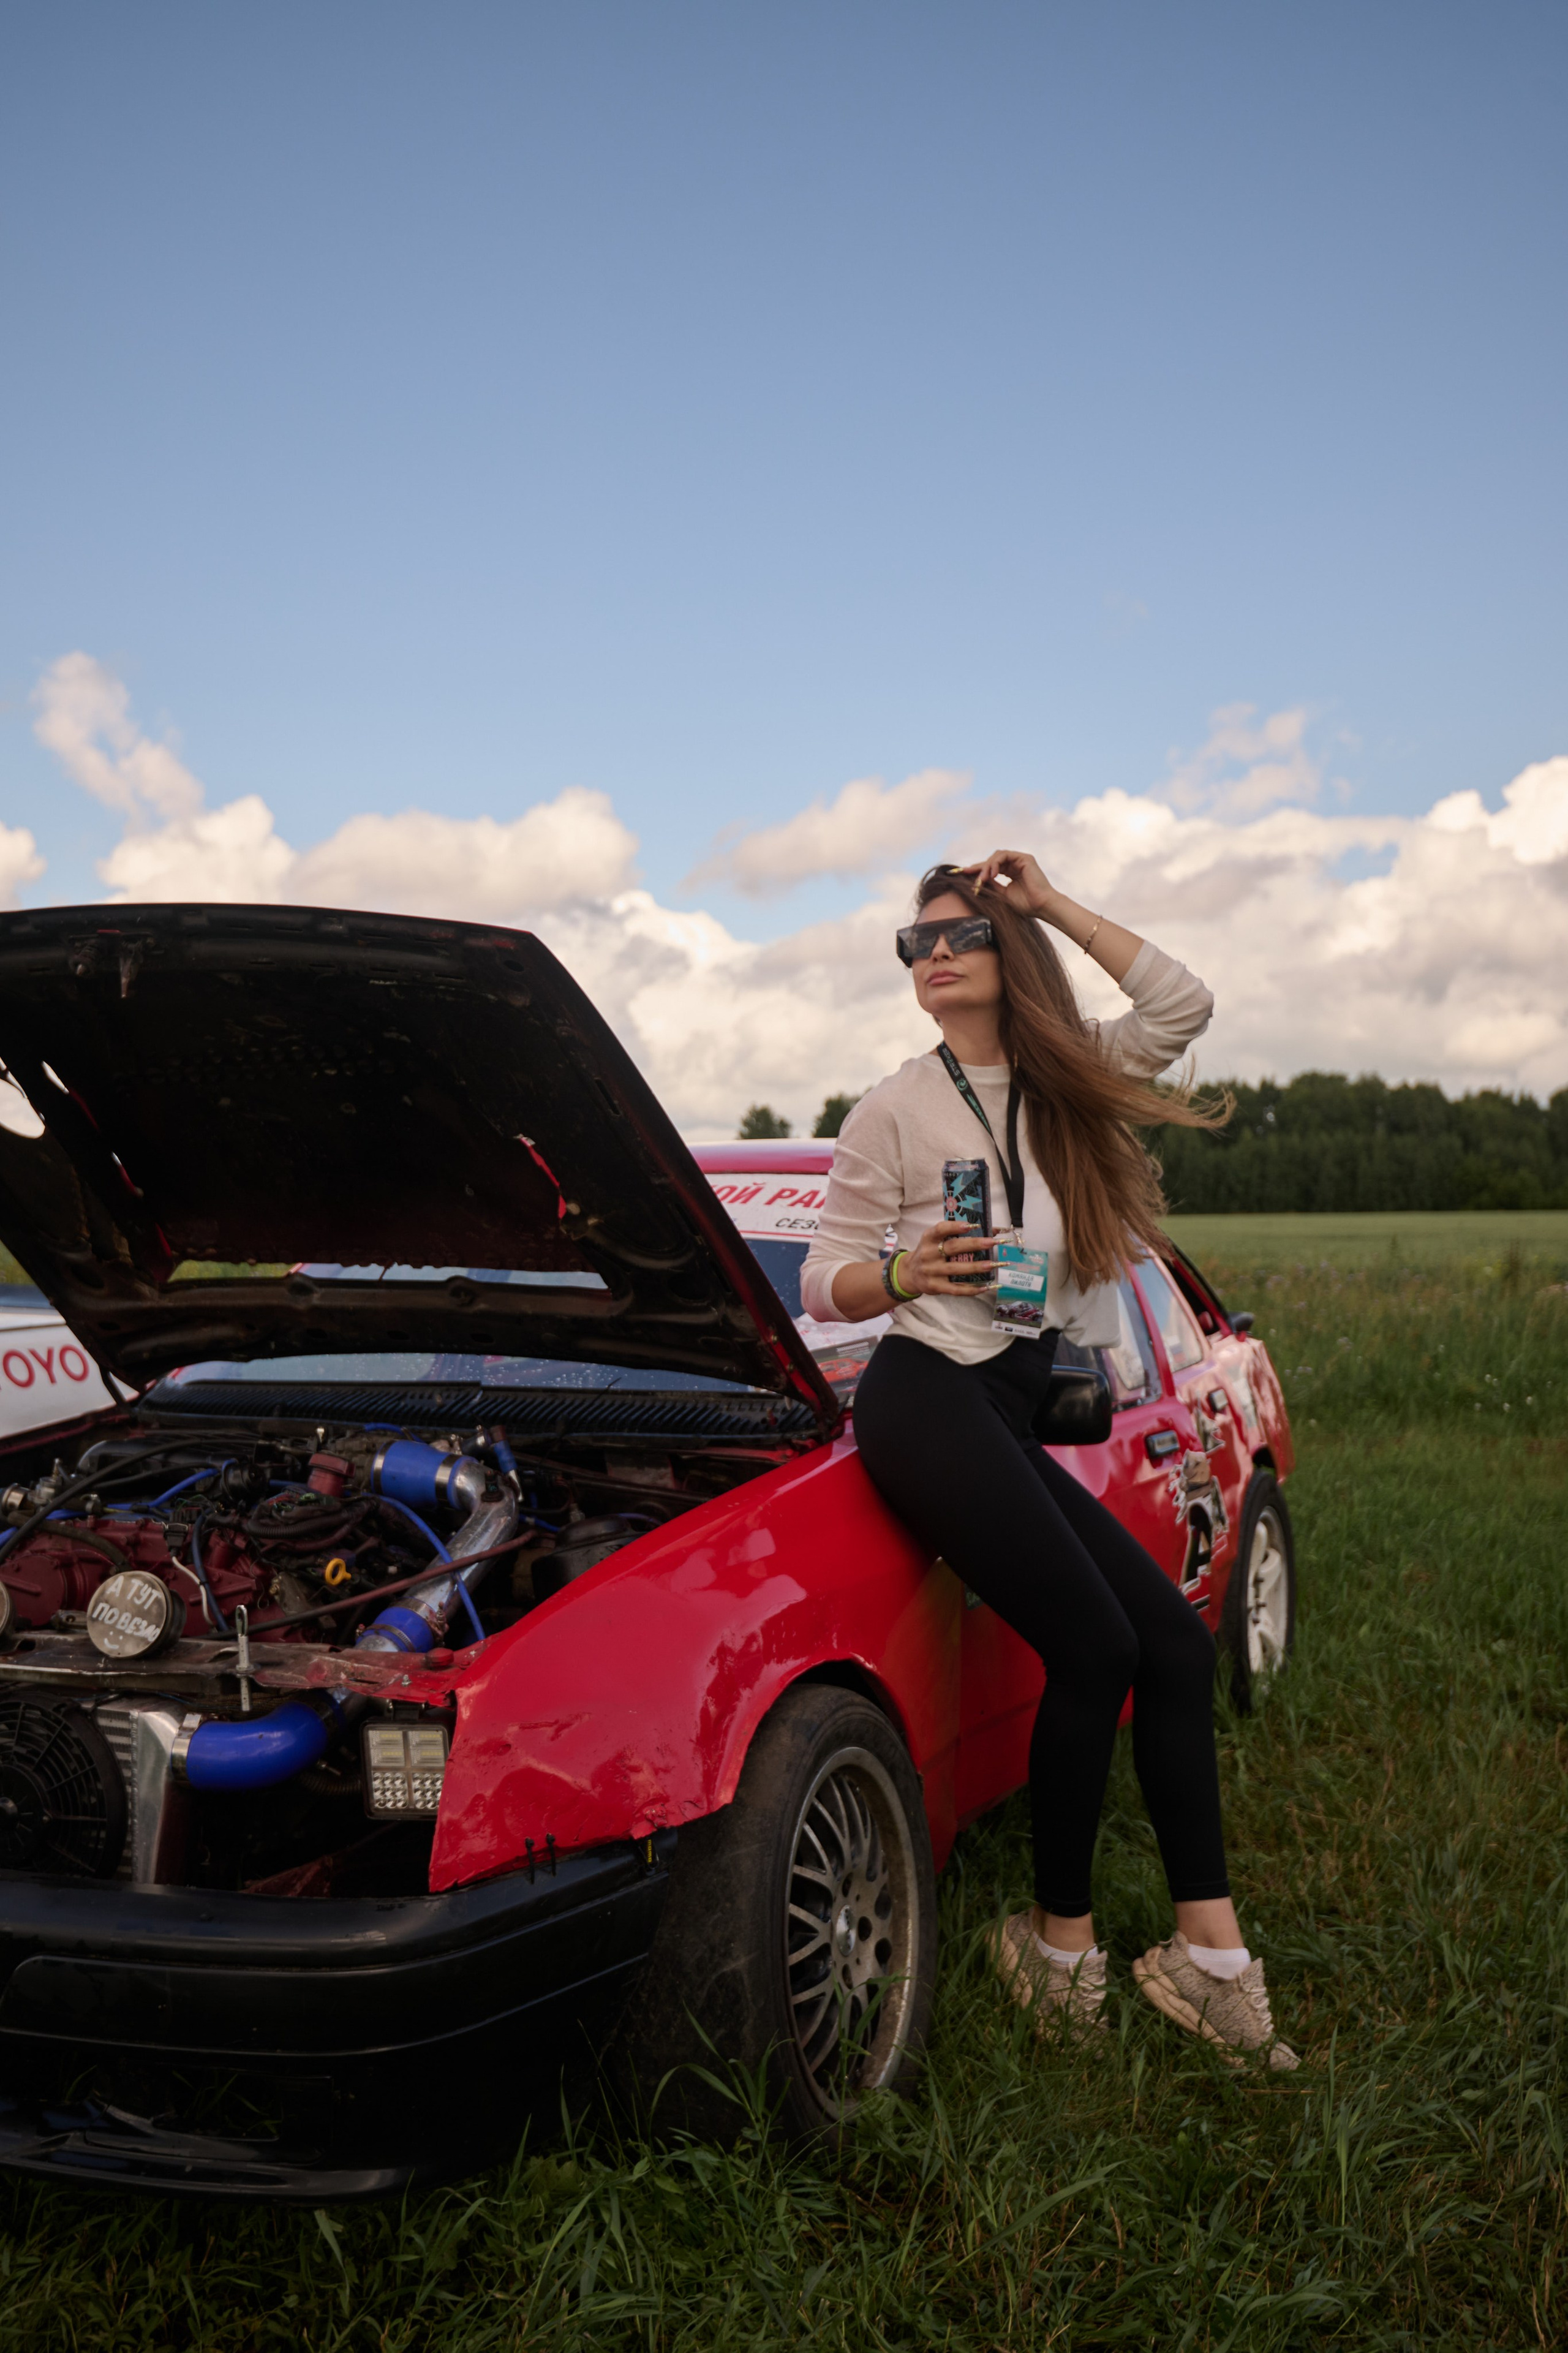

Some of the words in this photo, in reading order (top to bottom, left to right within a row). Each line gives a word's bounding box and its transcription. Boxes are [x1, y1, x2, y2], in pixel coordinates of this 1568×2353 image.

[710, 1182, 767, 1204] ОЙ
[0, 1345, 89, 1389] OYO
[105, 1574, 124, 1597] А
[126, 1578, 162, 1610] ТУТ
